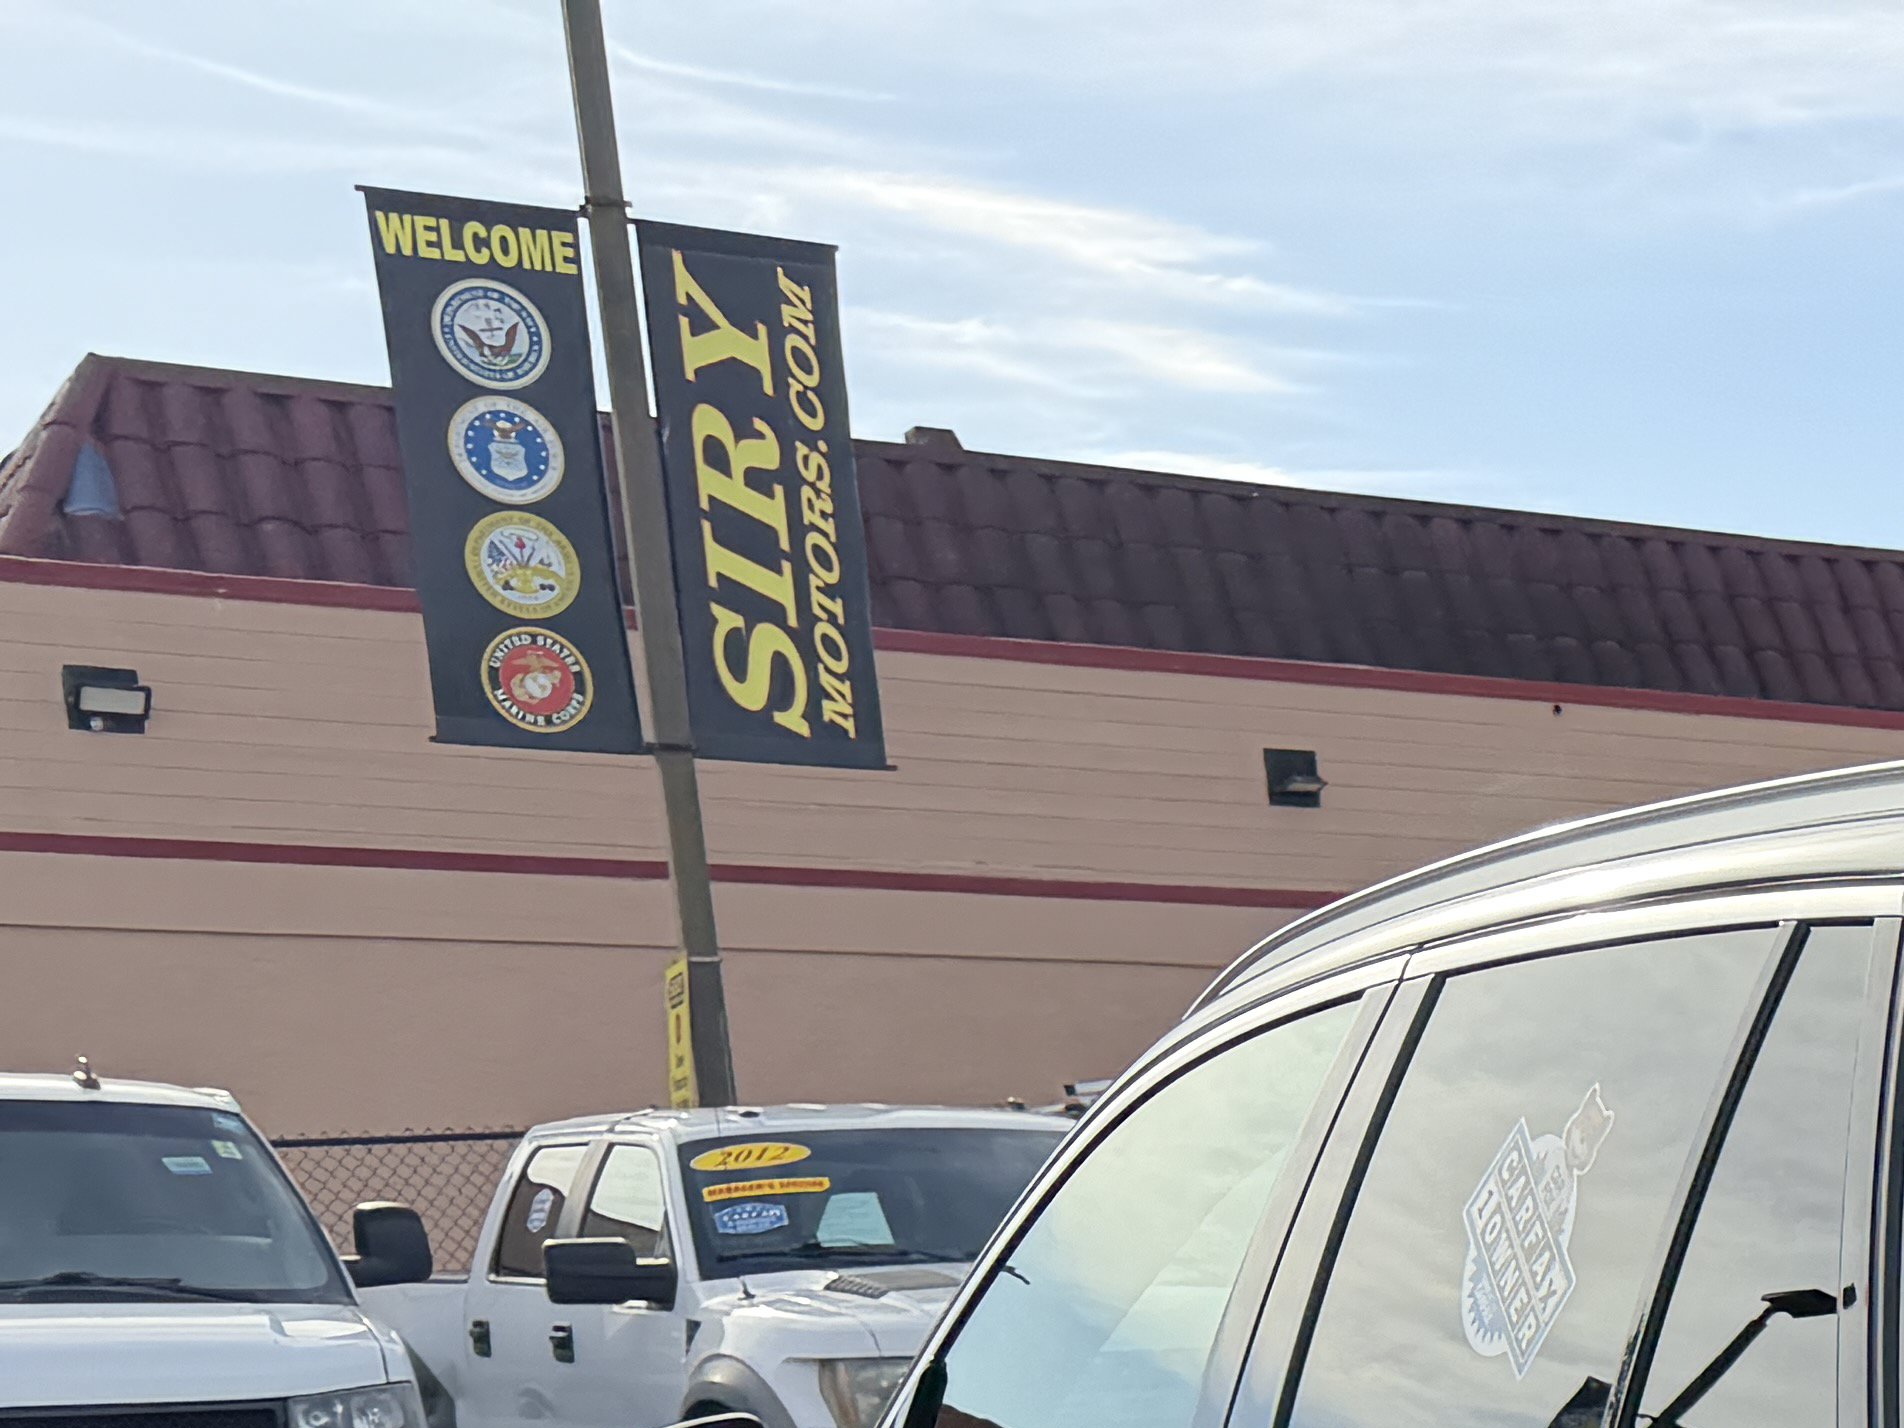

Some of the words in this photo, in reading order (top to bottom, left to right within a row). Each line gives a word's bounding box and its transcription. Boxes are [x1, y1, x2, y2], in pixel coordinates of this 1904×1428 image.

[375, 210, 578, 274] WELCOME
[672, 249, 810, 740] SIRY
[776, 266, 858, 739] MOTORS.COM
[713, 1146, 790, 1168] 2012
[1500, 1150, 1558, 1315] CARFAX
